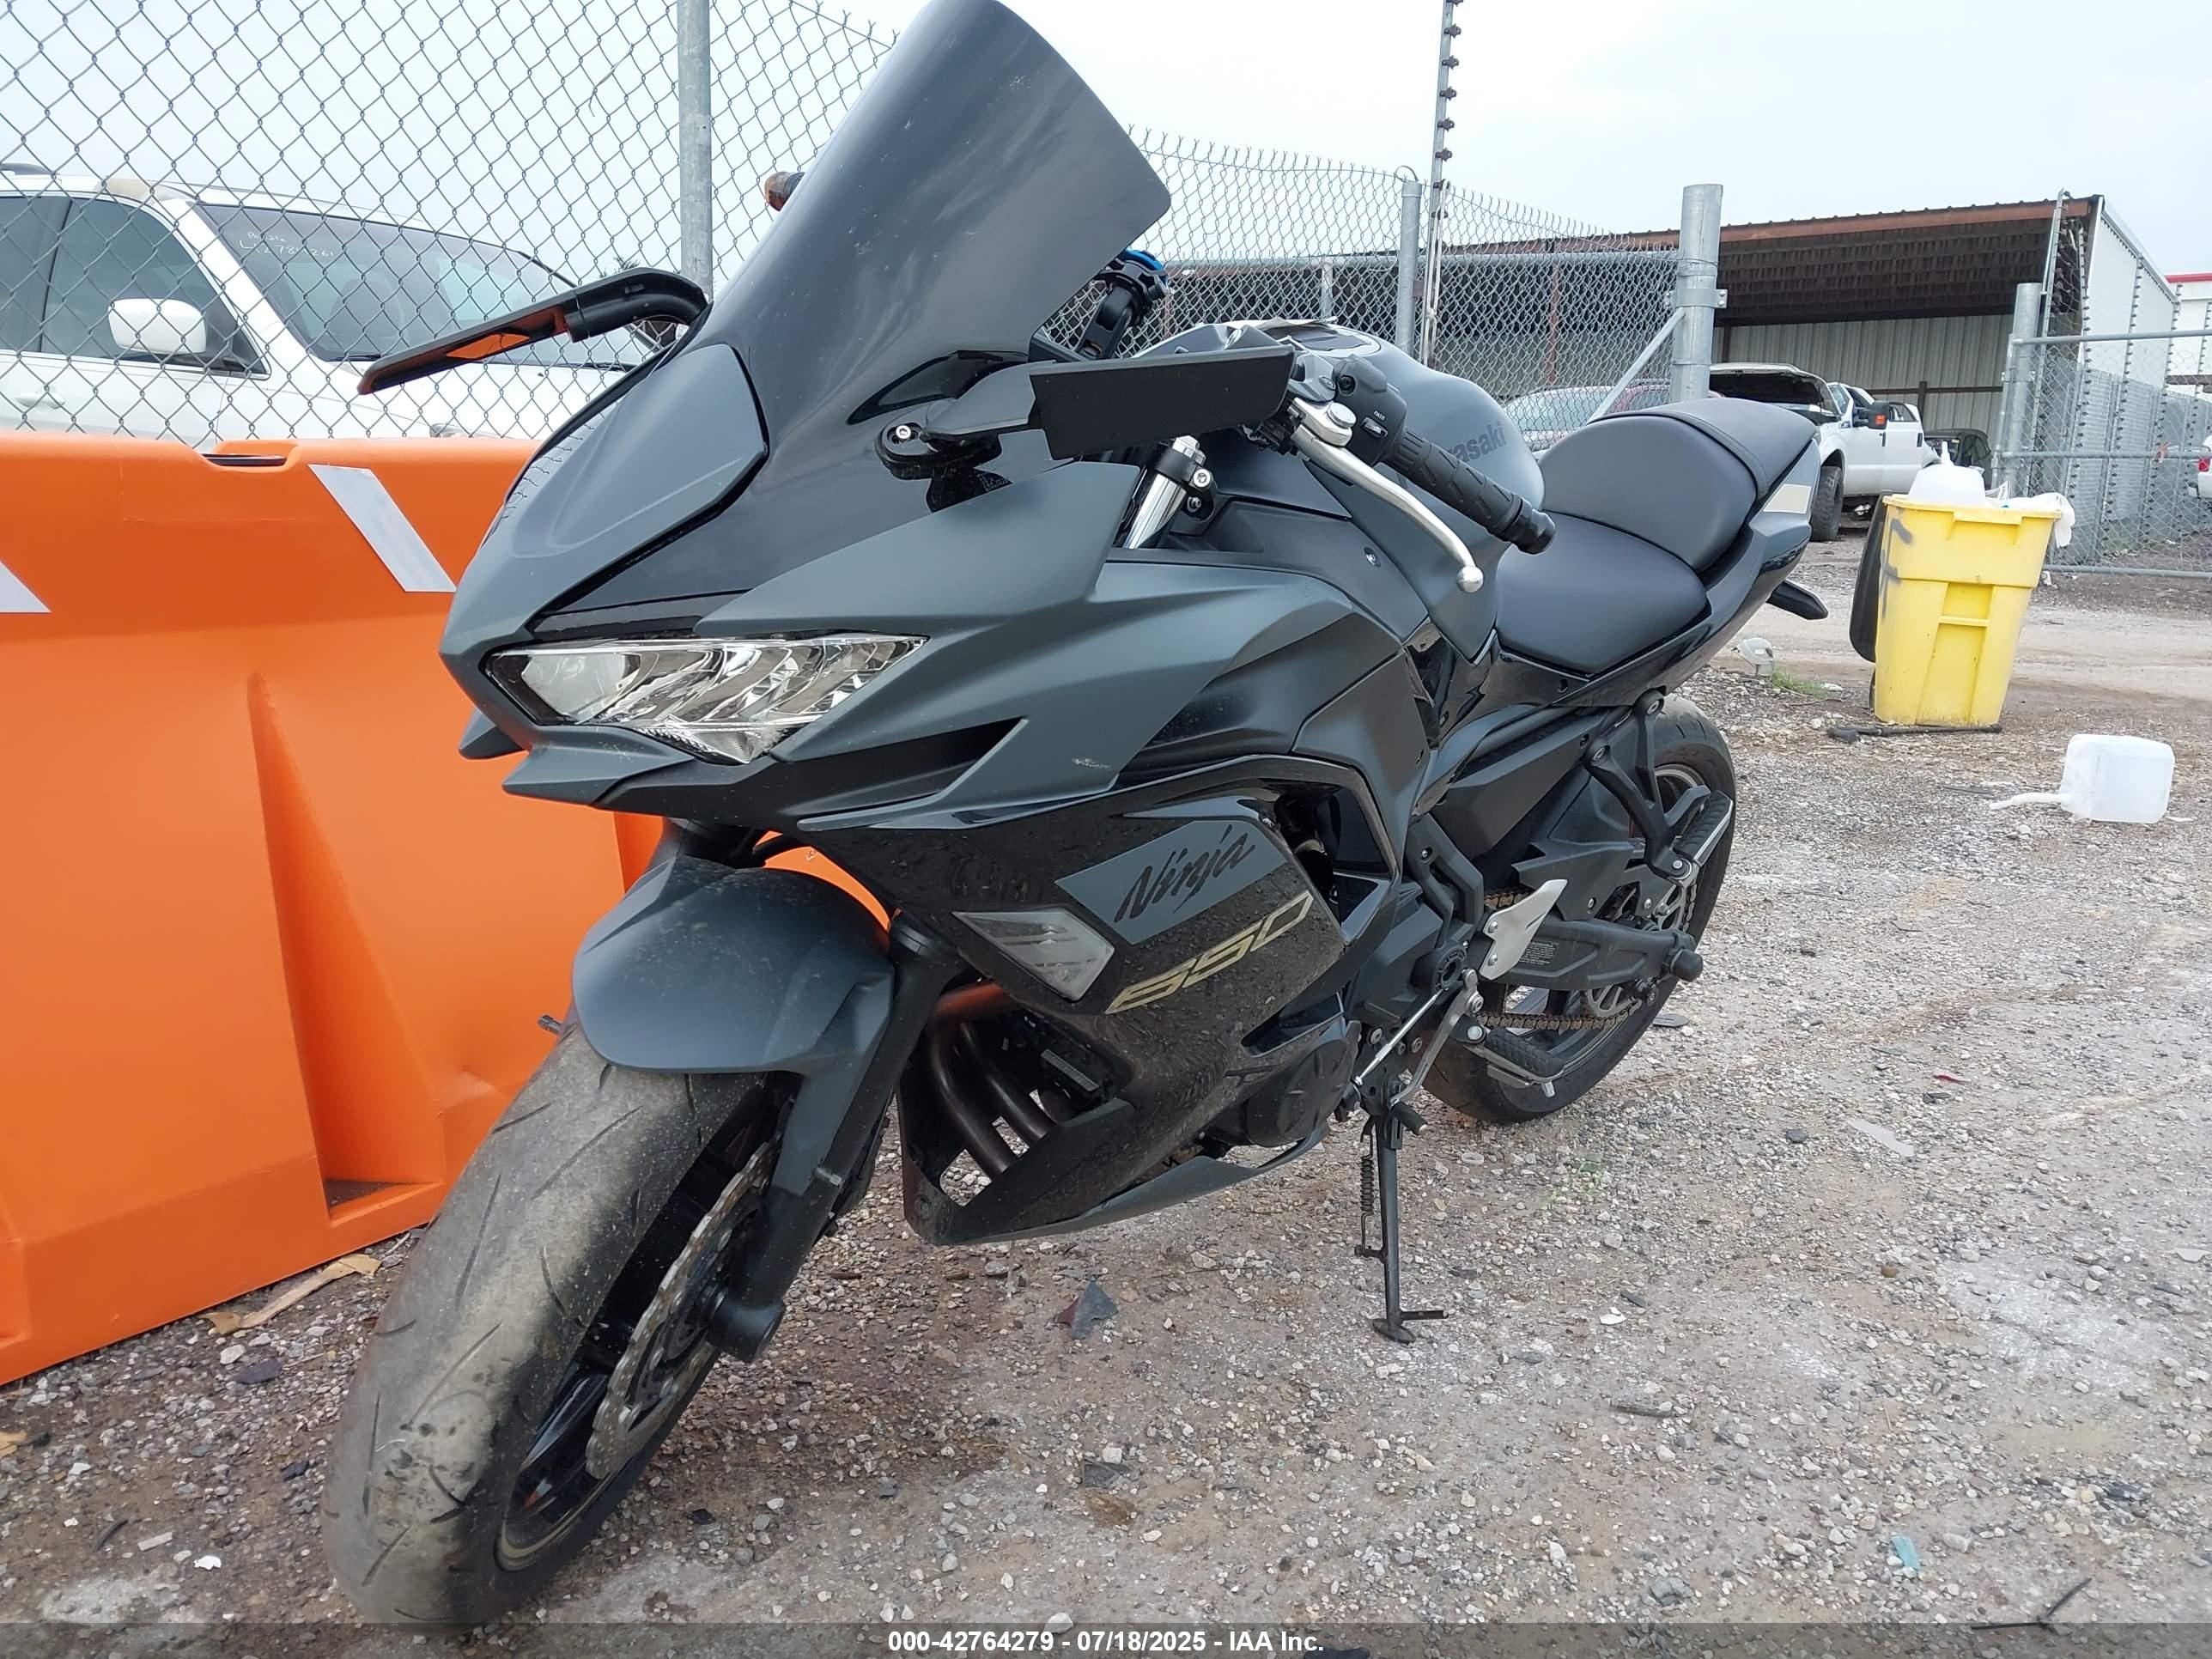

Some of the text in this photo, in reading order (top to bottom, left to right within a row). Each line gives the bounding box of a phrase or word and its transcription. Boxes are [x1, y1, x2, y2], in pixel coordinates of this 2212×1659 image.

[1447, 420, 1507, 462] asaki
[1114, 824, 1255, 923] Ninja
[1104, 890, 1314, 1014] 650
